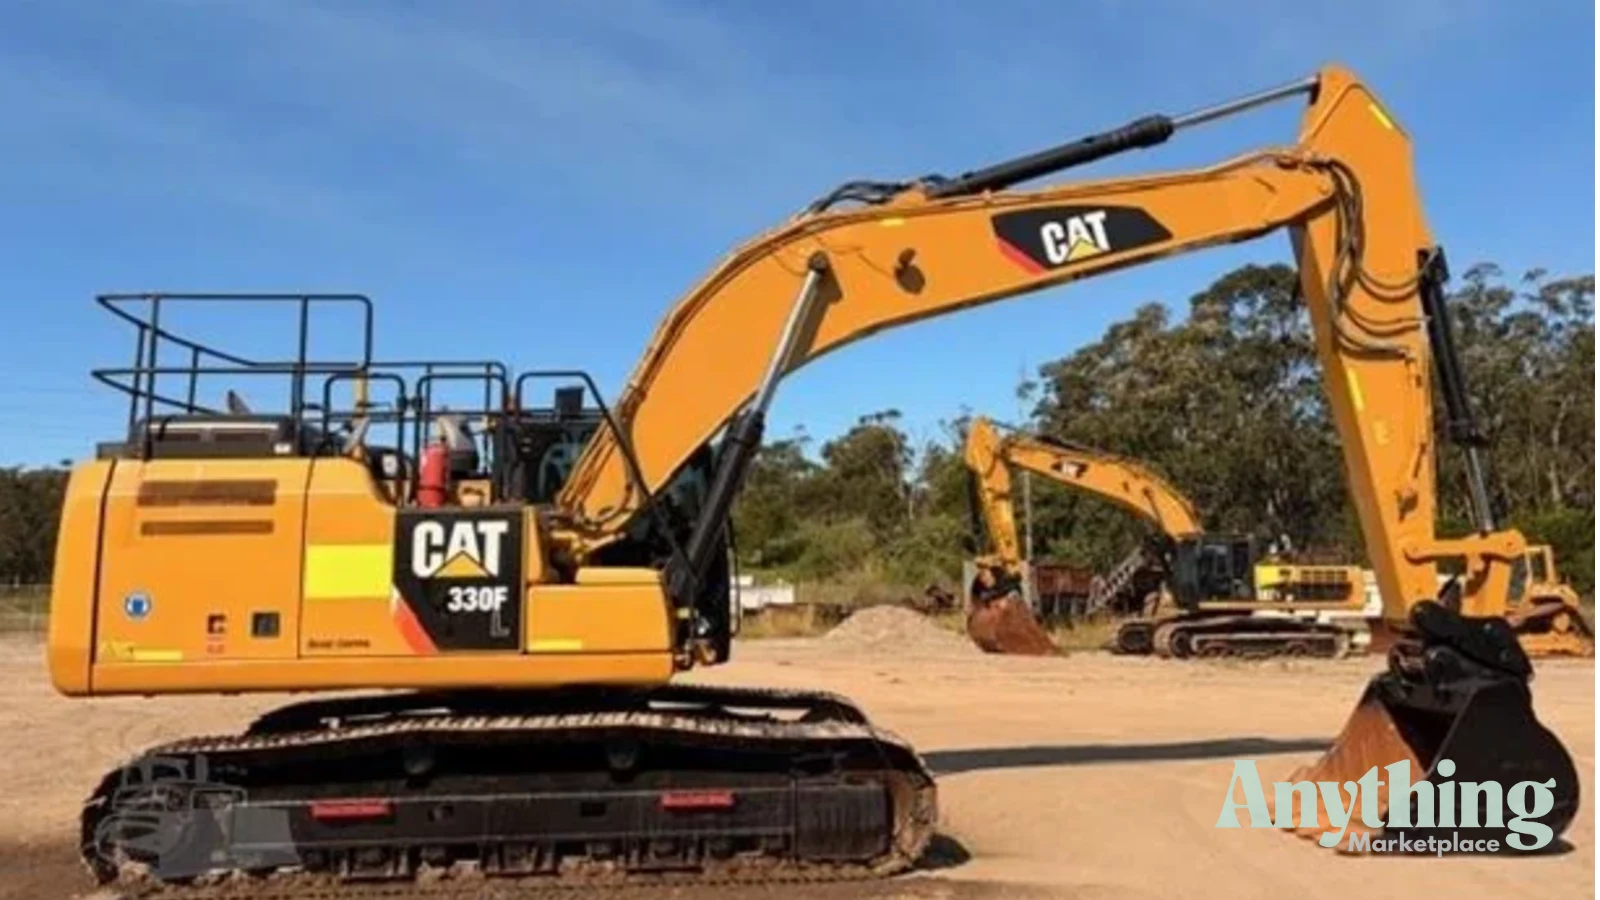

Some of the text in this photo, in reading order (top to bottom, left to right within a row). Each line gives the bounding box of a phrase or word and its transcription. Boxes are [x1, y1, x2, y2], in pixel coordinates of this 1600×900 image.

[1041, 209, 1111, 265] CAT
[412, 520, 509, 578] CAT
[446, 585, 509, 612] 330F
